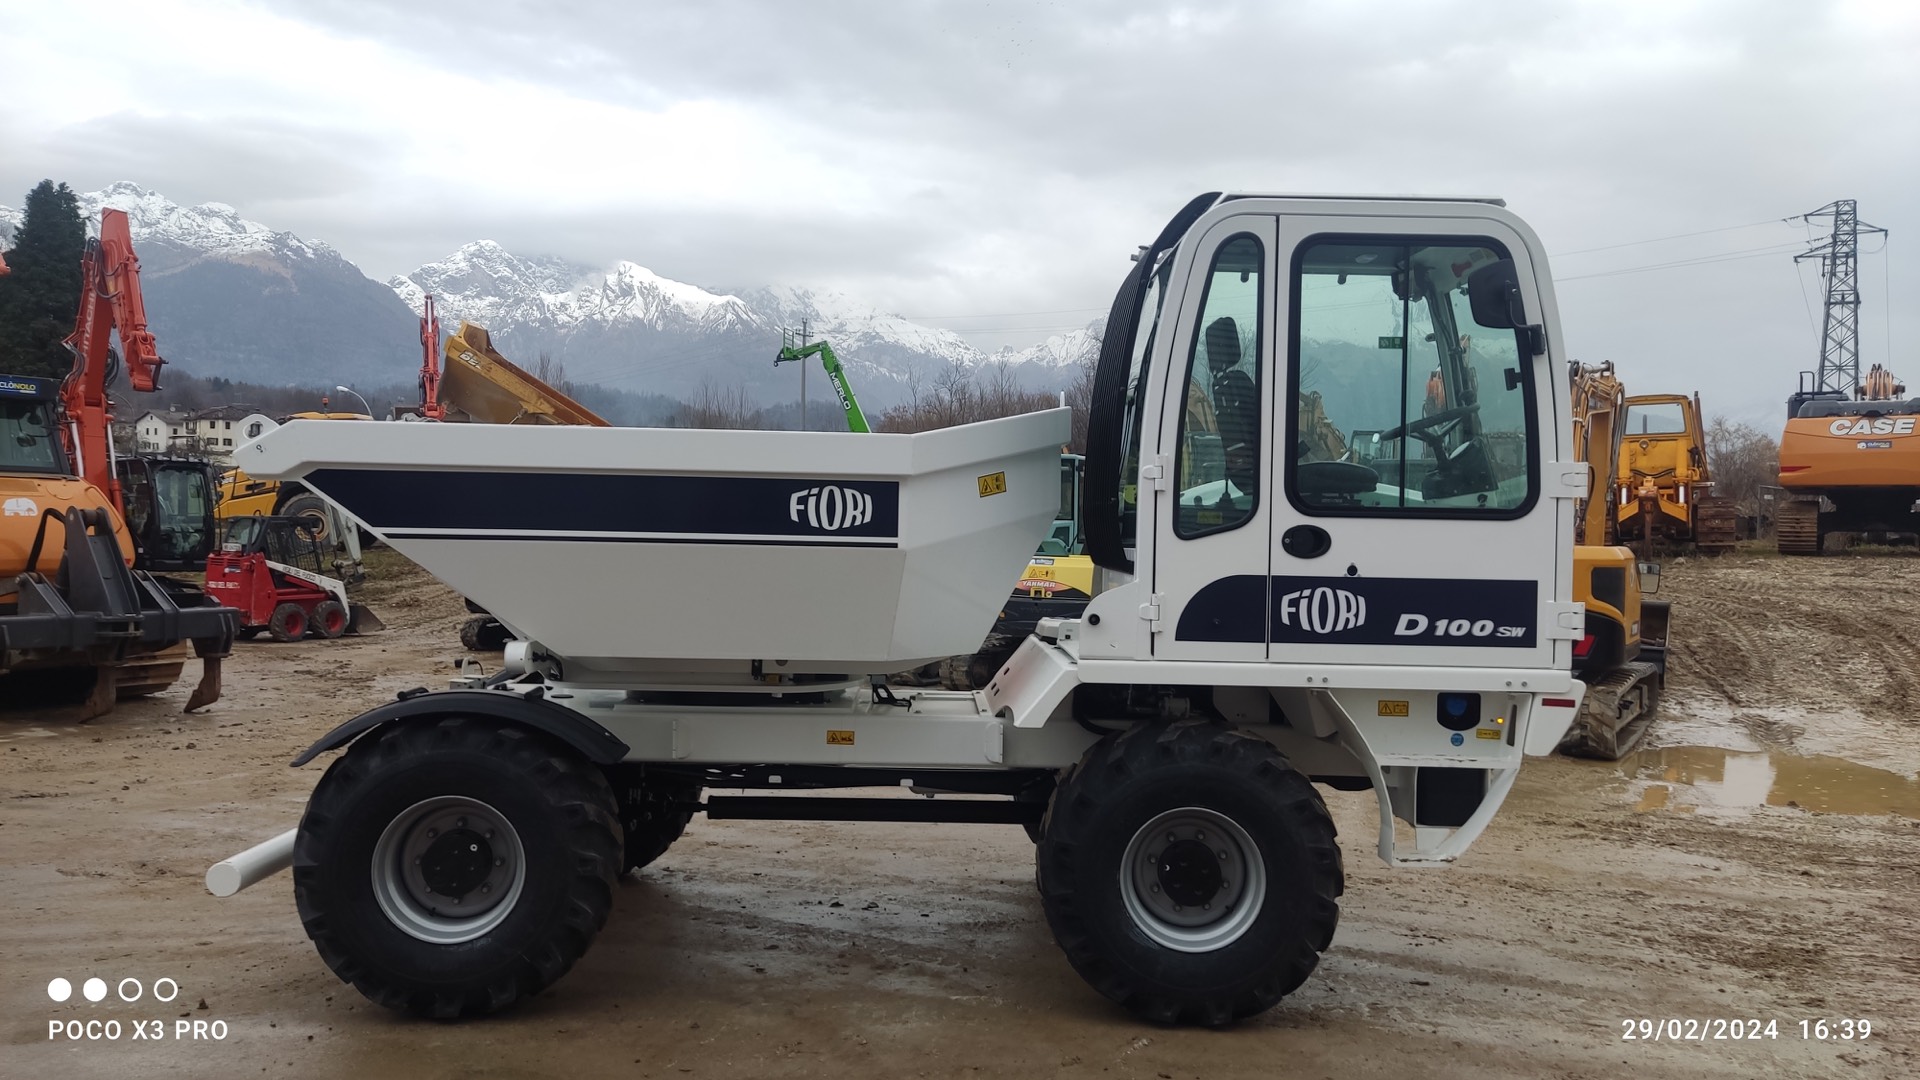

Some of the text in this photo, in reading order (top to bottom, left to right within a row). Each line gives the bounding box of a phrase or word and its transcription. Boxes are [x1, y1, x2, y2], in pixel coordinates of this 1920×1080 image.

[830, 372, 852, 410] MERLO
[1829, 418, 1917, 436] CASE
[1022, 580, 1056, 588] YANMAR
[1394, 613, 1527, 638] D 100 SW
